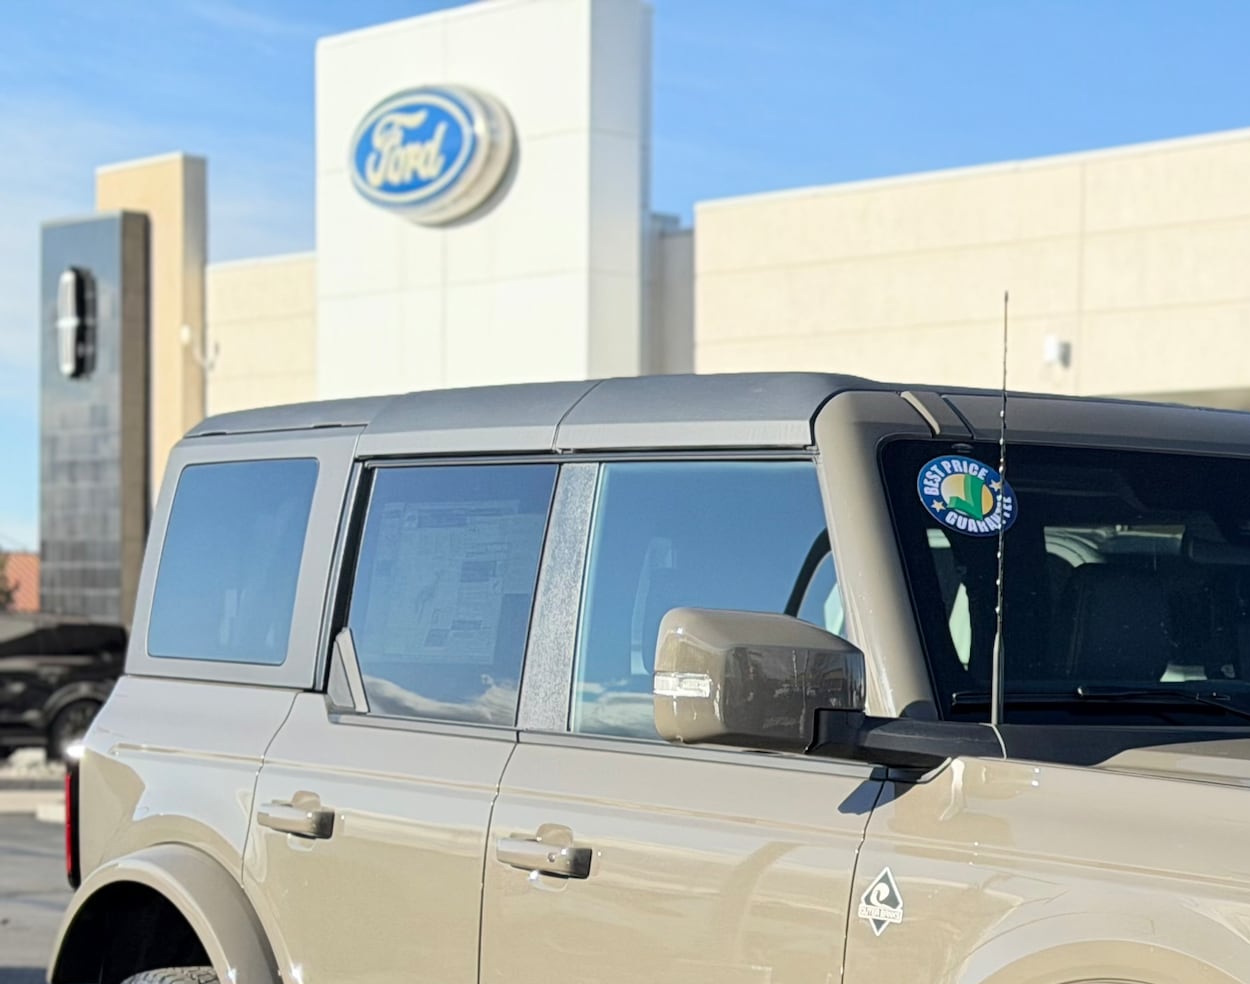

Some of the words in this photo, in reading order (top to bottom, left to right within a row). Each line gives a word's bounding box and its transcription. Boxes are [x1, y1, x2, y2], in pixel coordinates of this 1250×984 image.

[366, 109, 448, 188] Ford
[923, 464, 946, 496] BEST
[941, 459, 989, 481] PRICE
